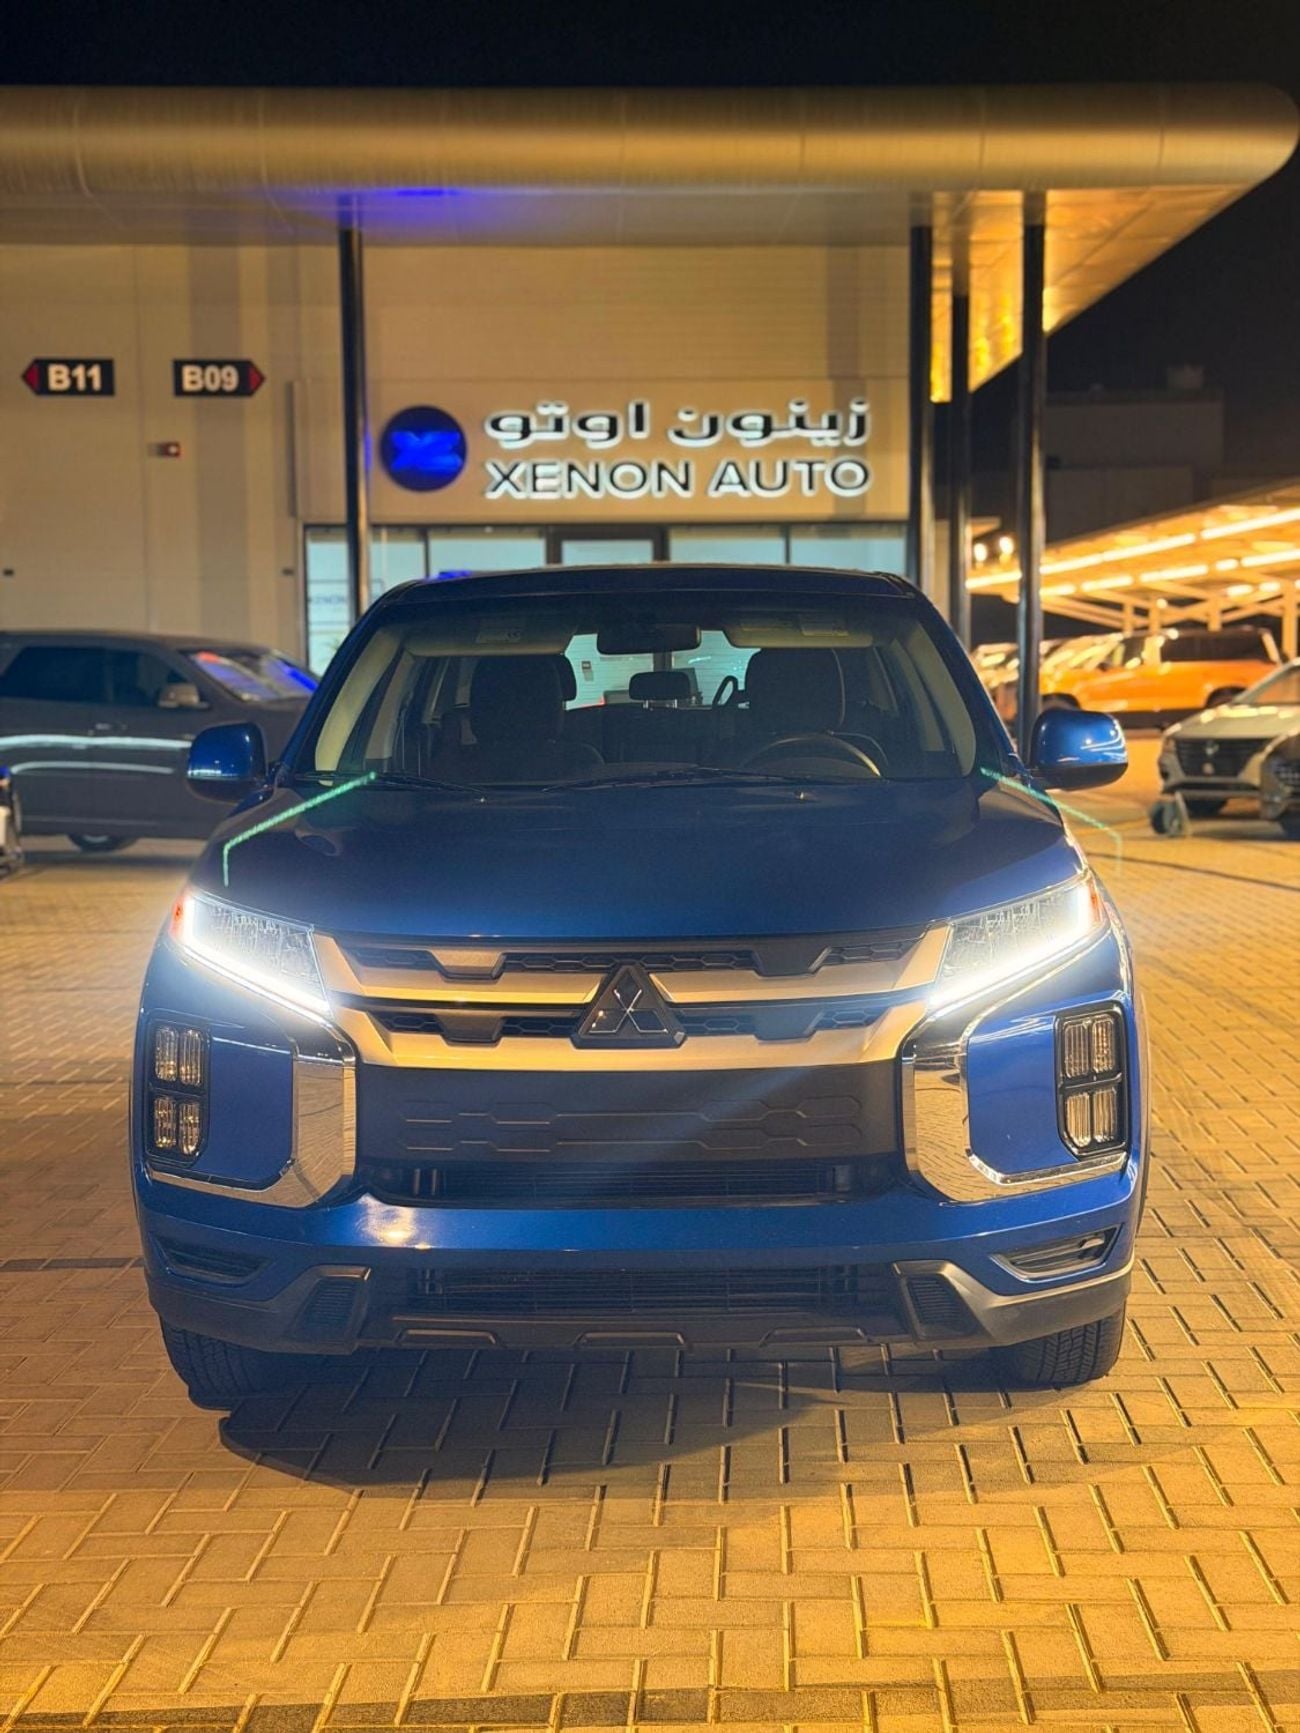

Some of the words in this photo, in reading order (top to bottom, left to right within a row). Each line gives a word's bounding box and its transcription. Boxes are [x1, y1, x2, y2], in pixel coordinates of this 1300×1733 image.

[48, 363, 102, 392] B11
[181, 364, 240, 393] B09
[484, 401, 651, 450] اوتو
[667, 398, 870, 449] زينون
[485, 457, 694, 499] XENON
[708, 457, 871, 498] AUTO
